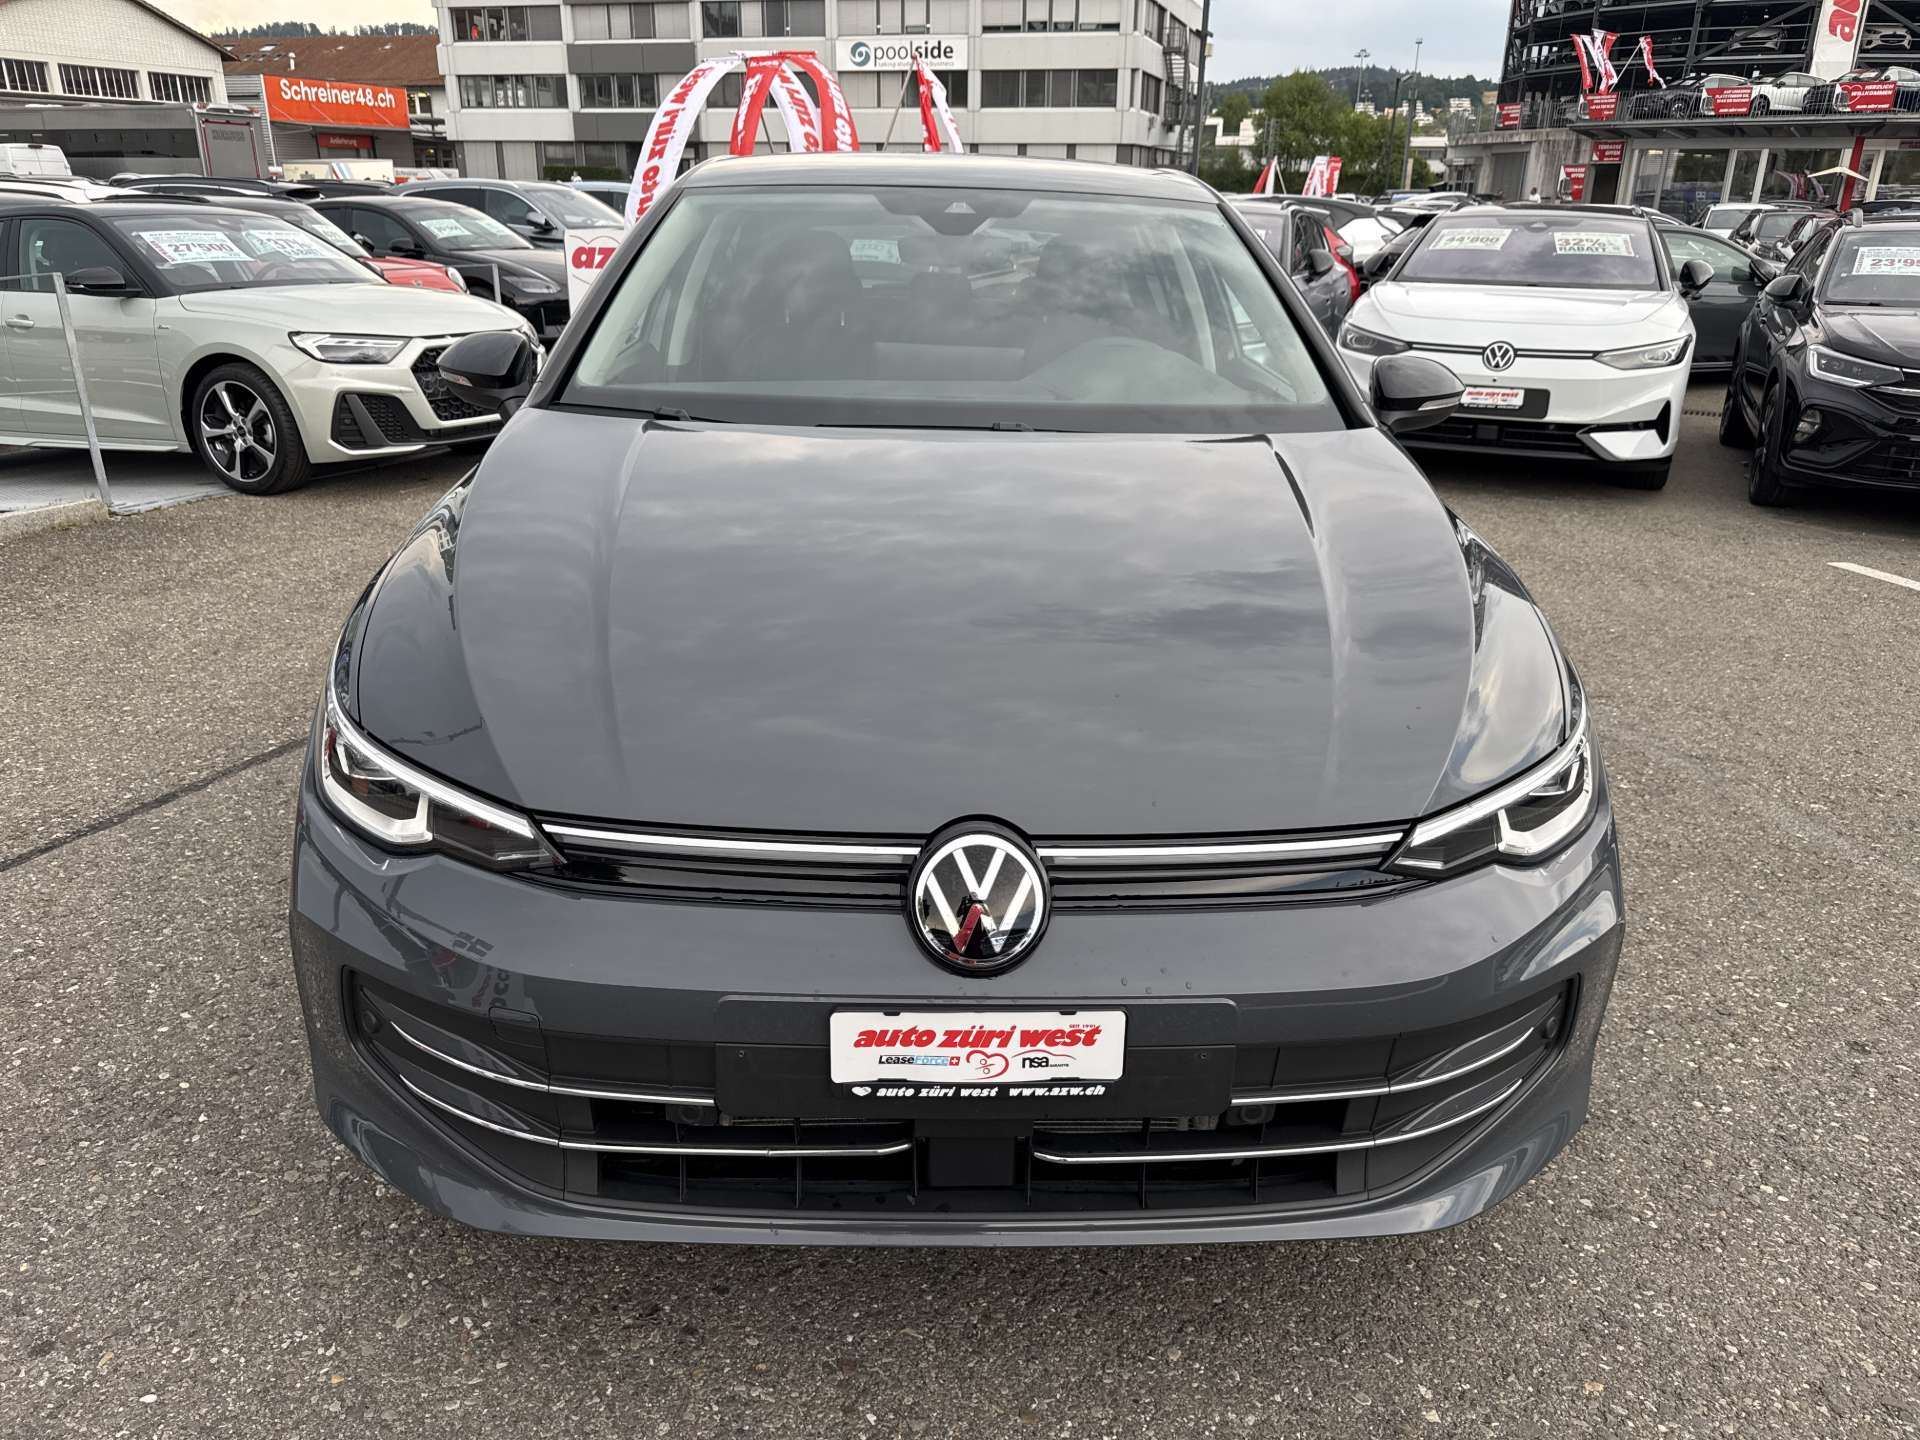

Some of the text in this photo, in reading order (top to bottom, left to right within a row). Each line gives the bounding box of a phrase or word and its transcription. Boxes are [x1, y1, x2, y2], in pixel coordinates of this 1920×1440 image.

[874, 40, 954, 67] poolside
[279, 78, 395, 108] Schreiner48.ch
[1557, 239, 1606, 248] 32%
[571, 246, 617, 269] az
[853, 1025, 1103, 1048] auto züri west
[879, 1055, 950, 1067] LeaseForce
[1022, 1056, 1049, 1068] nsa
[876, 1084, 1106, 1097] auto züri west www.azw.ch
